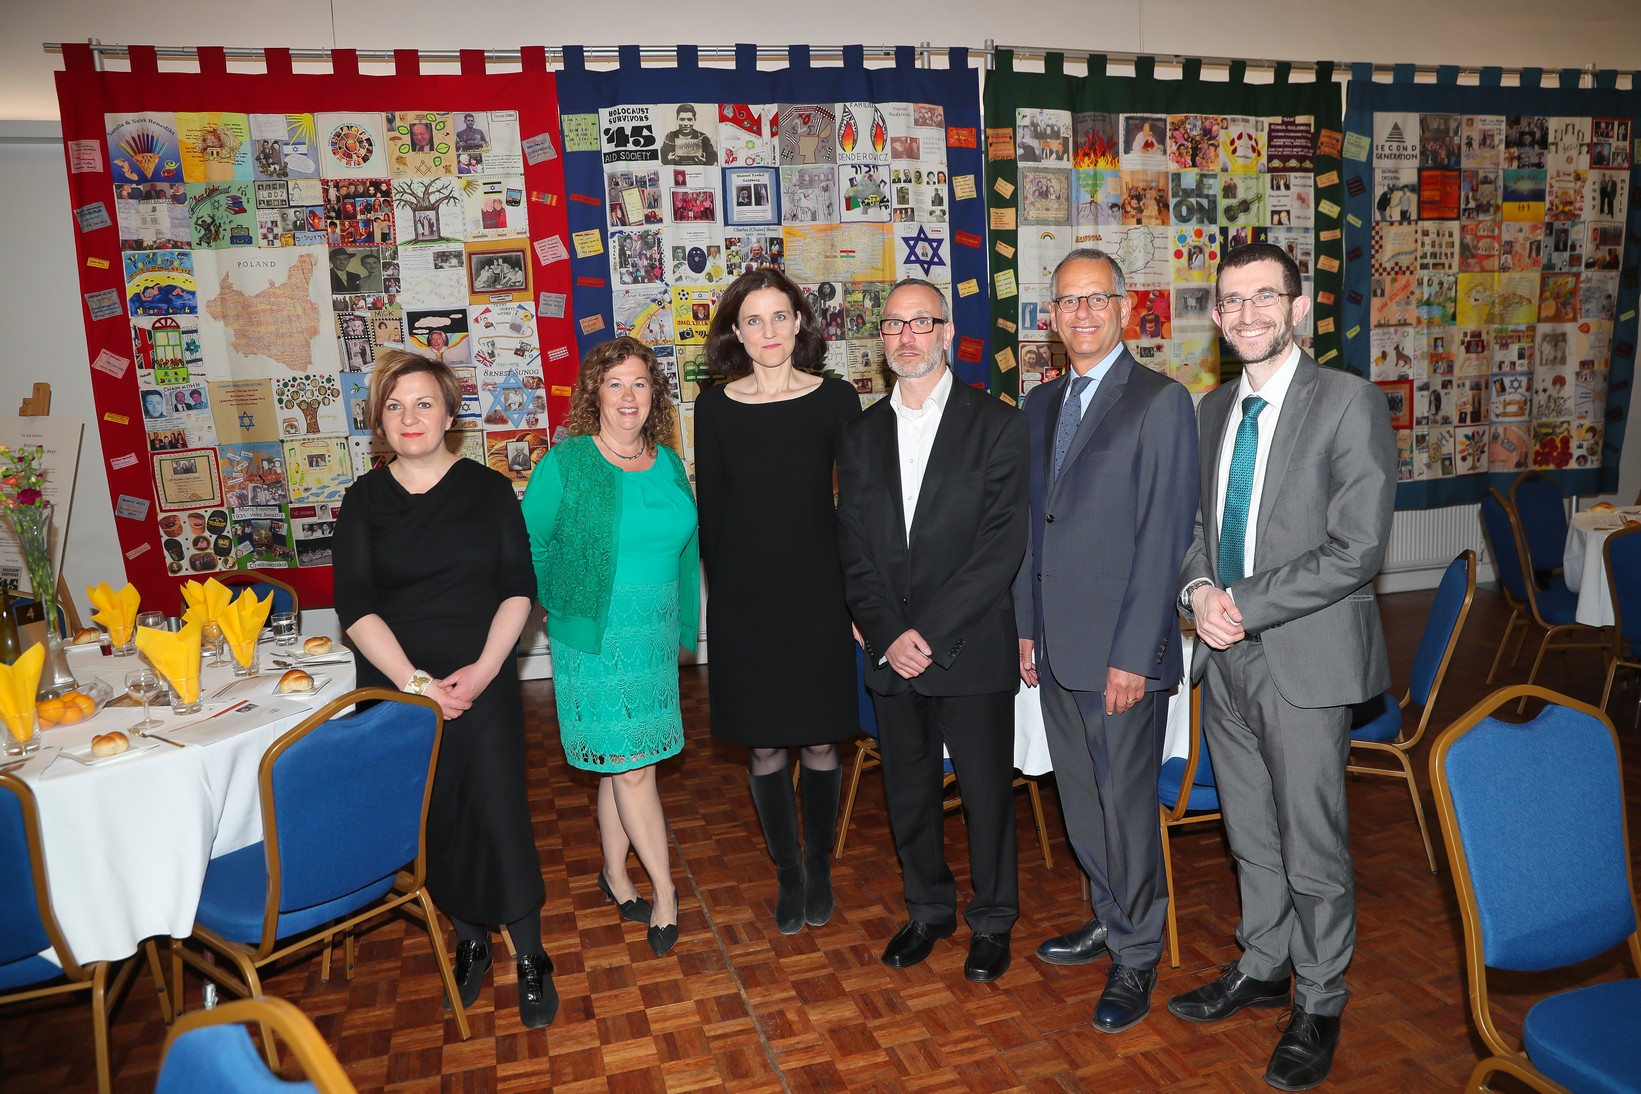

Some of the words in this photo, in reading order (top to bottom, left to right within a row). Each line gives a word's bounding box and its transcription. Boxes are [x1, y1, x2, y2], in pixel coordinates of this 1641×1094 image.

[608, 107, 649, 117] HOLOCAUST
[608, 115, 649, 125] SURVIVORS
[1375, 144, 1417, 152] SECOND
[604, 153, 618, 163] AID
[620, 151, 651, 160] SOCIETY
[838, 152, 889, 161] DENDEROWICZ
[1375, 153, 1418, 161] GENERATION
[374, 310, 394, 318] MICK
[26, 607, 36, 620] 4
